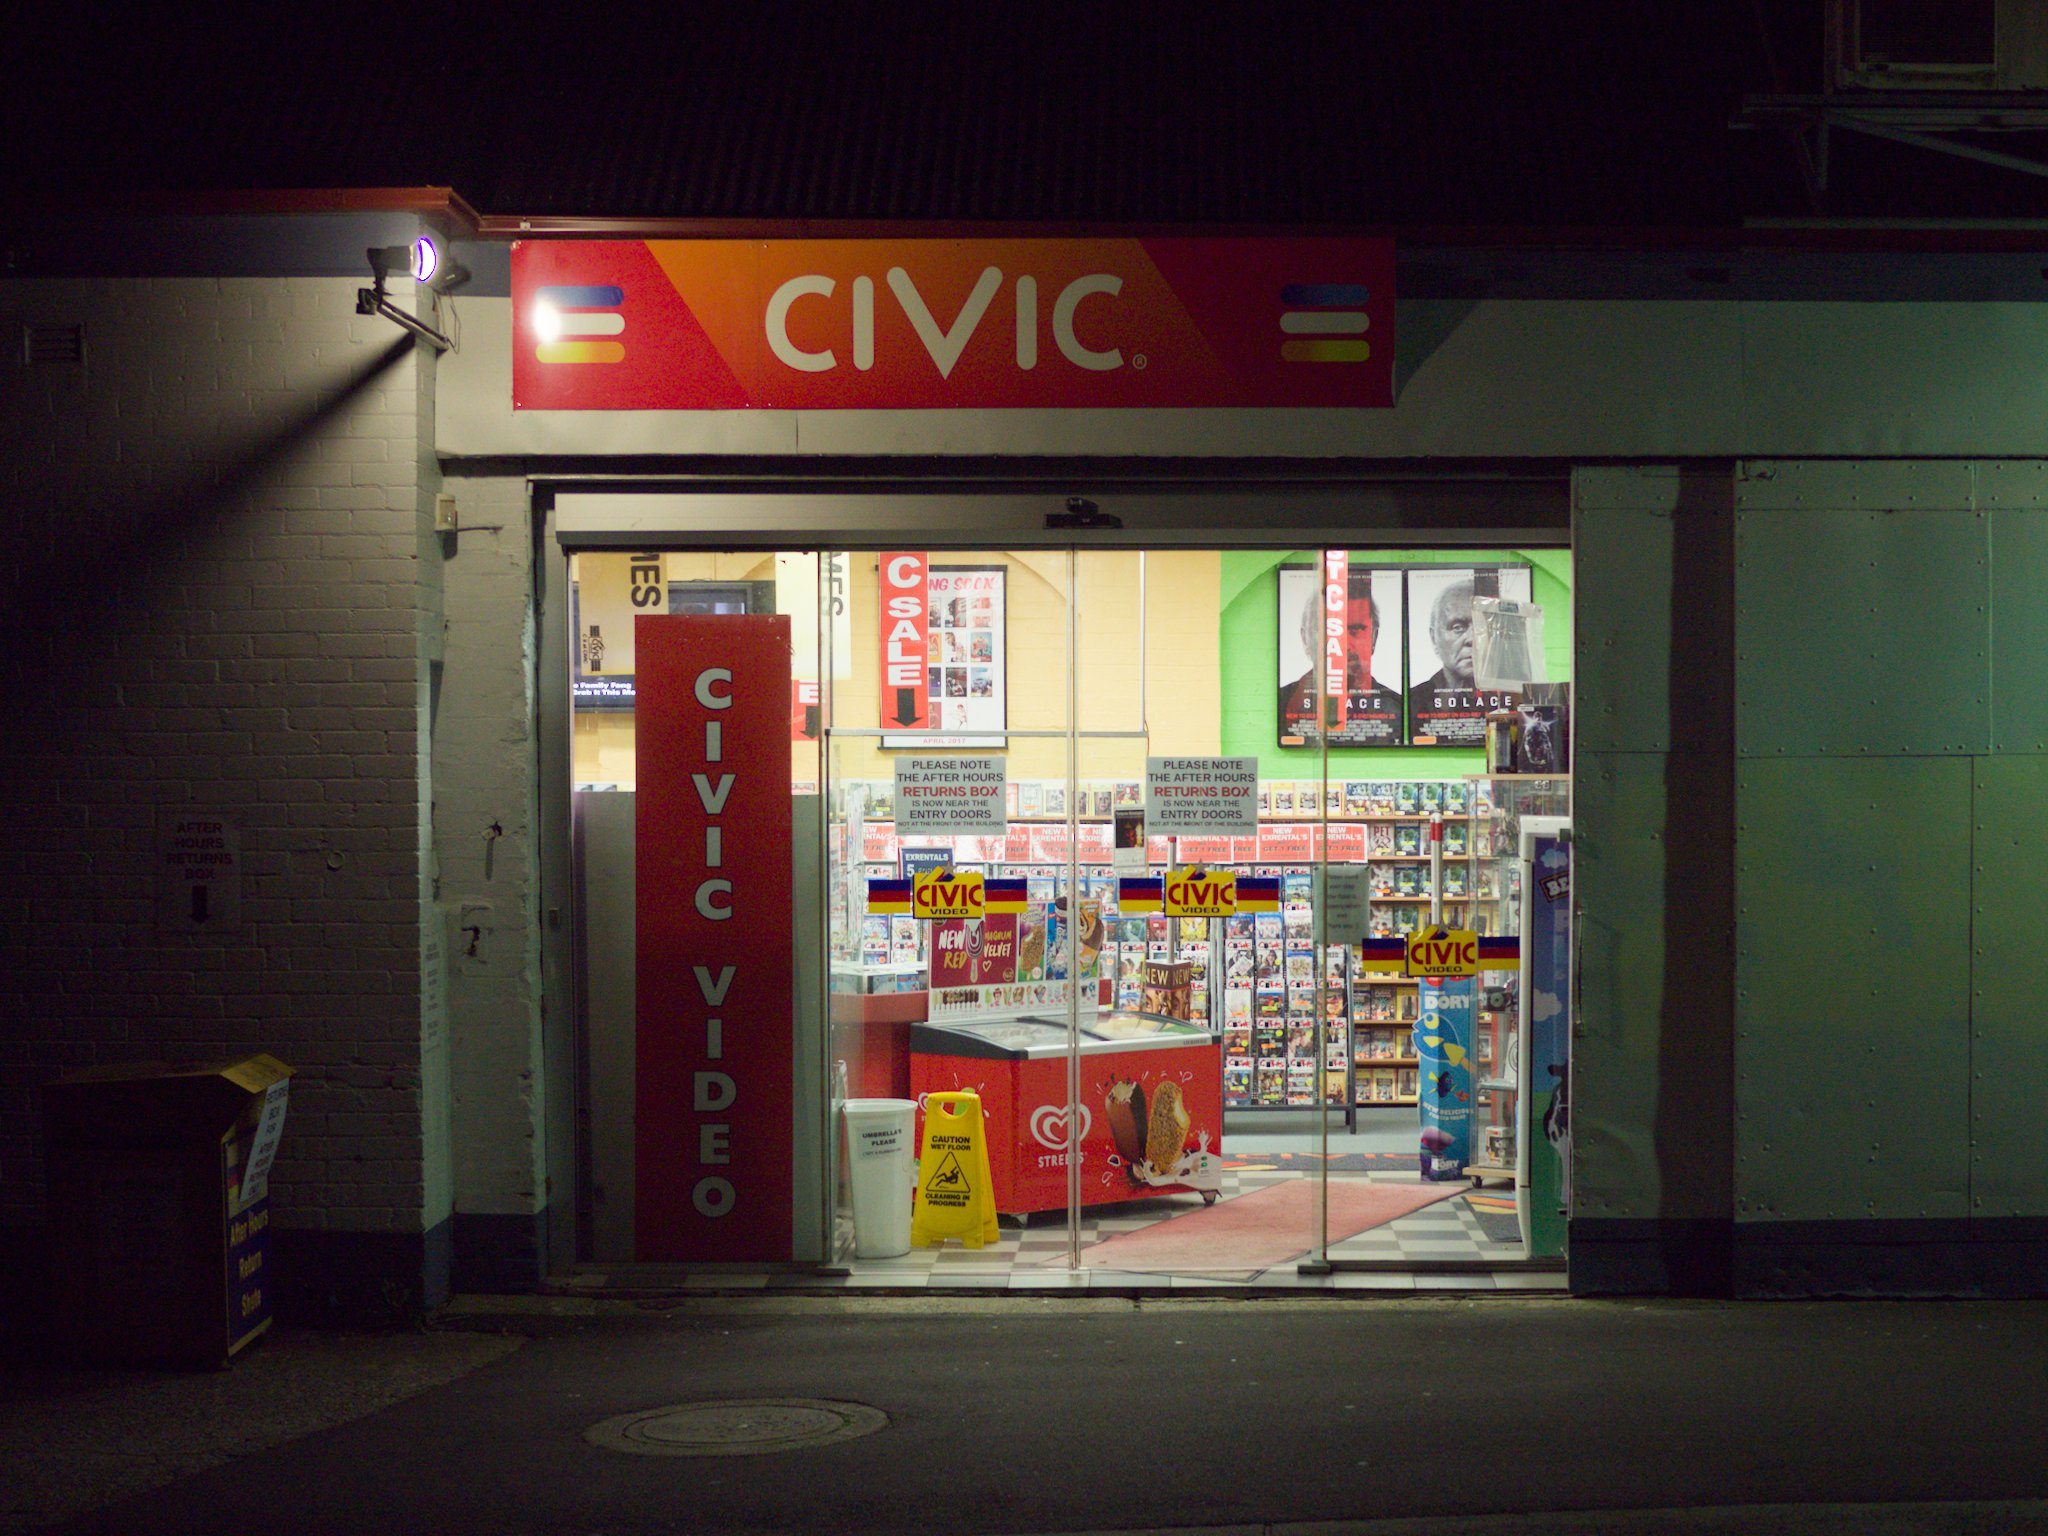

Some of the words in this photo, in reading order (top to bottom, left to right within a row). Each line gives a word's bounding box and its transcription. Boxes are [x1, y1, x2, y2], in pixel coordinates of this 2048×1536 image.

[765, 266, 1126, 379] CIVIC
[887, 596, 922, 686] SALE
[580, 682, 608, 690] Family
[611, 682, 632, 690] Fang
[1303, 698, 1381, 709] SACE
[1434, 696, 1512, 708] SOLACE
[912, 760, 957, 770] PLEASE
[960, 760, 991, 769] NOTE
[1163, 760, 1208, 770] PLEASE
[1212, 760, 1243, 769] NOTE
[897, 773, 919, 782] THE
[922, 773, 960, 782] AFTER
[963, 773, 1004, 782] HOURS
[1148, 773, 1170, 782] THE
[1174, 773, 1211, 782] AFTER
[1214, 773, 1255, 782] HOURS
[691, 667, 737, 922] CIVIC
[903, 786, 967, 797] RETURNS
[970, 786, 999, 797] BOX
[1154, 786, 1218, 797] RETURNS
[1221, 786, 1250, 797] BOX
[910, 810, 947, 819] ENTRY
[950, 810, 992, 819] DOORS
[1161, 810, 1198, 819] ENTRY
[1201, 810, 1243, 819] DOORS
[177, 822, 222, 833] AFTER
[176, 838, 224, 848] HOURS
[167, 853, 232, 864] RETURNS
[905, 853, 949, 861] EXRENTALS
[185, 868, 215, 879] BOX
[907, 864, 915, 877] 5
[916, 884, 982, 907] CIVIC
[1167, 882, 1234, 906] CIVIC
[1181, 906, 1220, 914] VIDEO
[939, 928, 966, 950] NEW
[985, 930, 1012, 940] MAGNUM
[984, 942, 1011, 958] VELVET
[1410, 941, 1475, 965] CIVIC
[944, 951, 967, 969] RED
[1145, 968, 1169, 985] NEW
[1172, 967, 1190, 984] NEW
[1424, 995, 1472, 1009] DORY
[691, 965, 737, 1218] VIDEO
[872, 1139, 896, 1147] PLEASE
[932, 1136, 970, 1144] CAUTION
[1038, 1152, 1085, 1168] STREES
